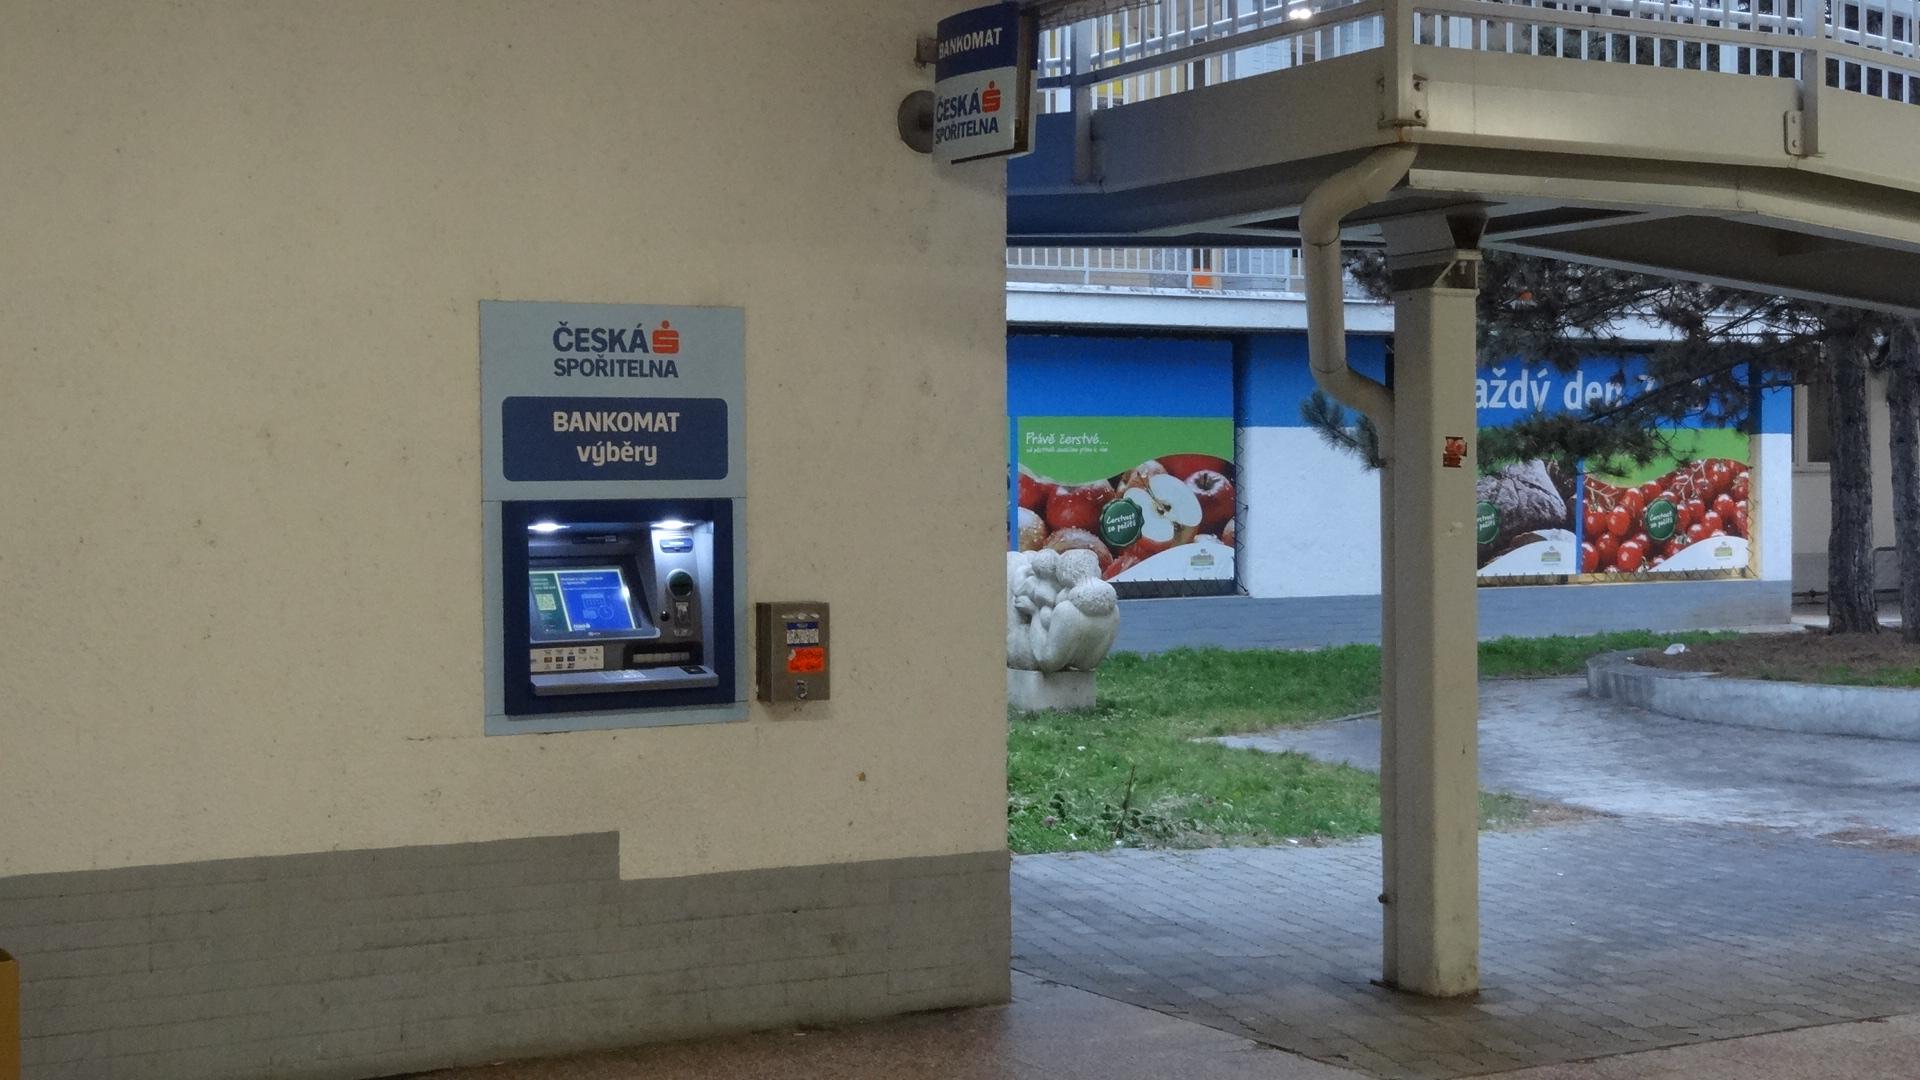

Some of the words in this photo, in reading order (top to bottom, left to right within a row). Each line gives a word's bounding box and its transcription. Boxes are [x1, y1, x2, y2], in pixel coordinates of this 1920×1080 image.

[938, 27, 1003, 59] BANKOMAT
[936, 87, 981, 123] ČESKÁ
[935, 116, 999, 145] SPOŘITELNA
[552, 321, 650, 354] ČESKÁ
[553, 355, 679, 378] SPOŘITELNA
[1474, 367, 1551, 413] aždý
[1563, 369, 1623, 411] den
[553, 411, 680, 433] BANKOMAT
[1025, 431, 1056, 445] Právě
[577, 441, 657, 467] výběry
